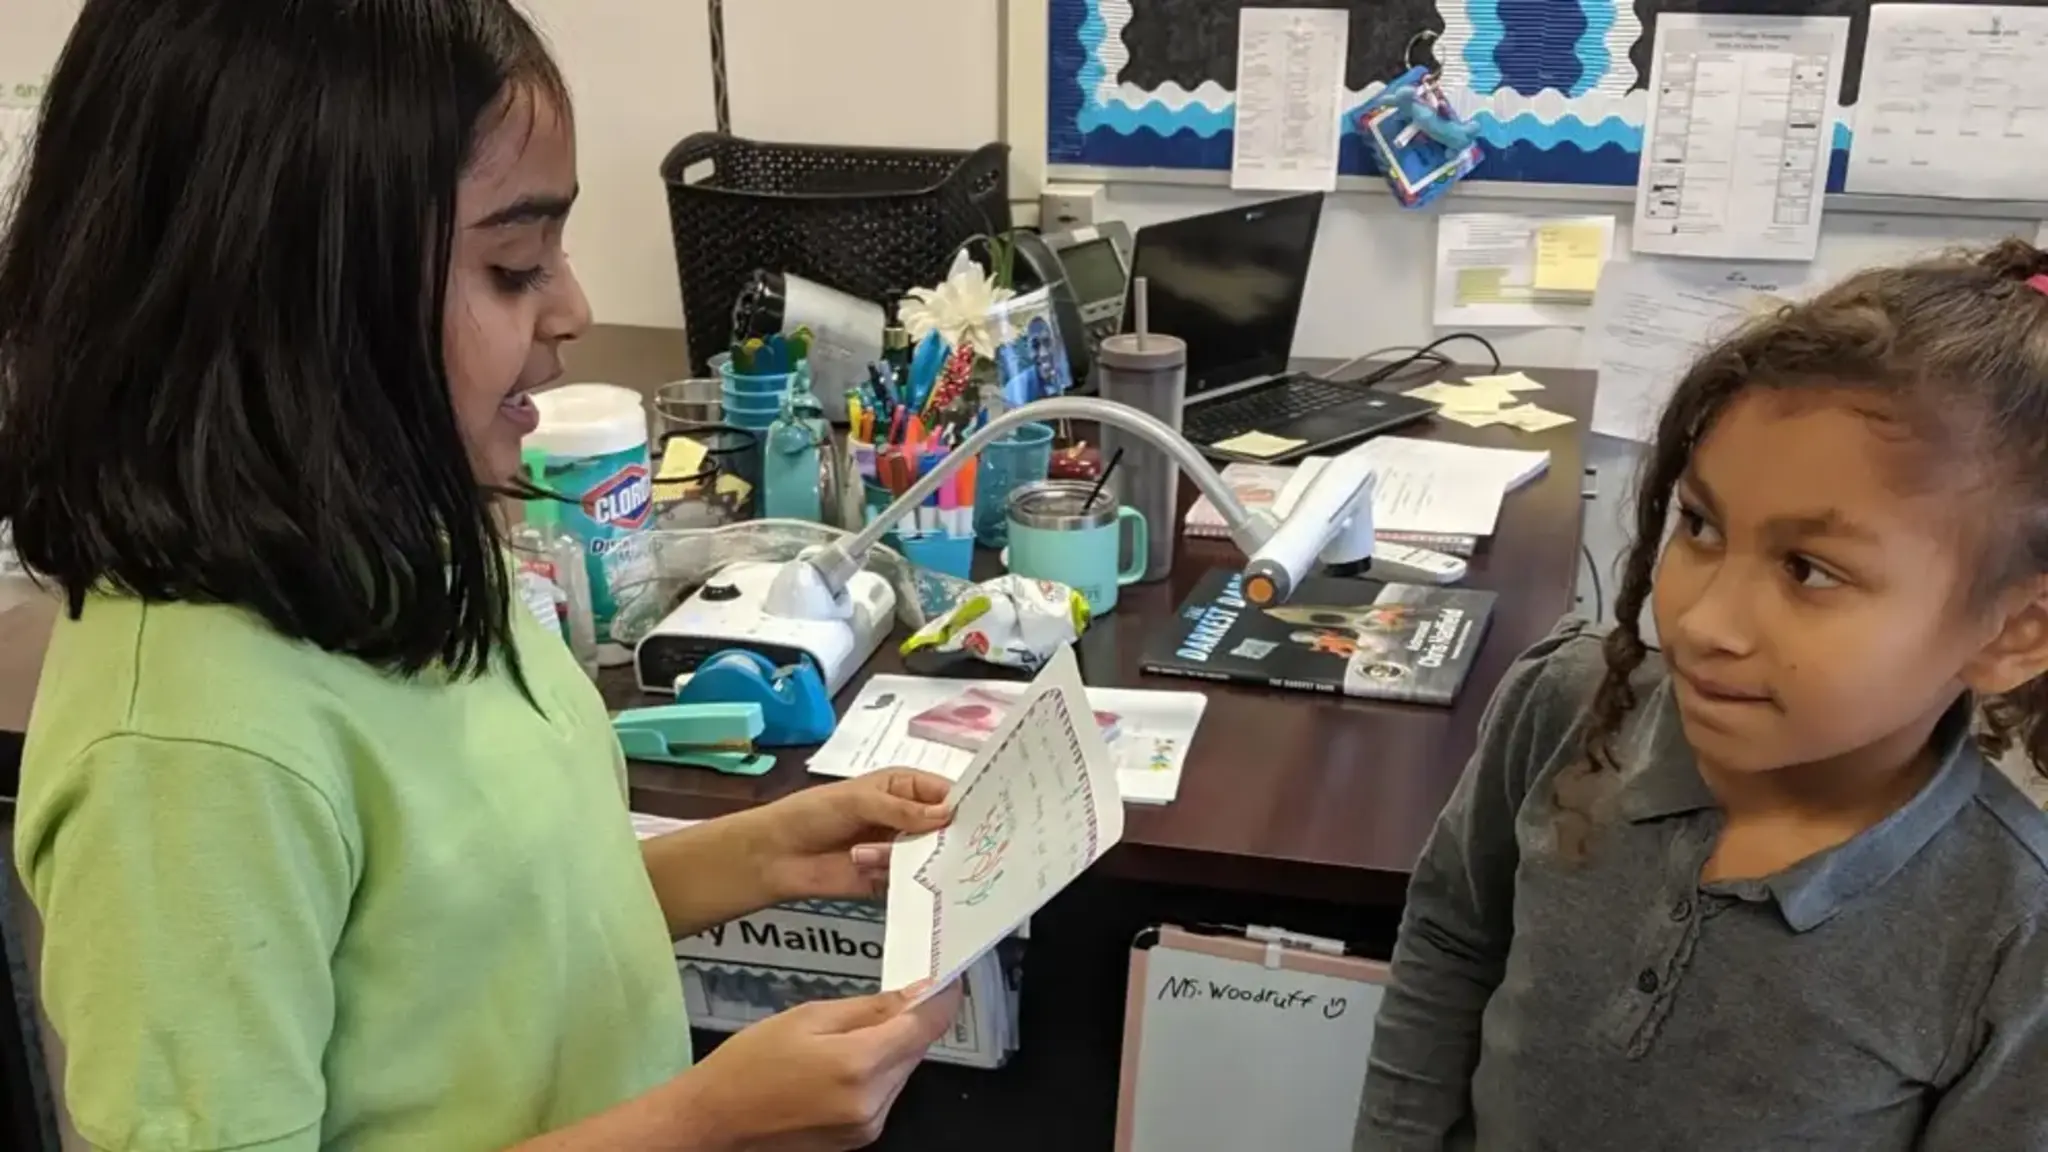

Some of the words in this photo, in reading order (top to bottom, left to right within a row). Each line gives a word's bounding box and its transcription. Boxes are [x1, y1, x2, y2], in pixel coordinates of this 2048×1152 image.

[595, 473, 650, 524] CLOR
[1176, 606, 1239, 662] DARKEST
[739, 920, 884, 959] Mailbo
[1208, 981, 1317, 1009] Woodruff
